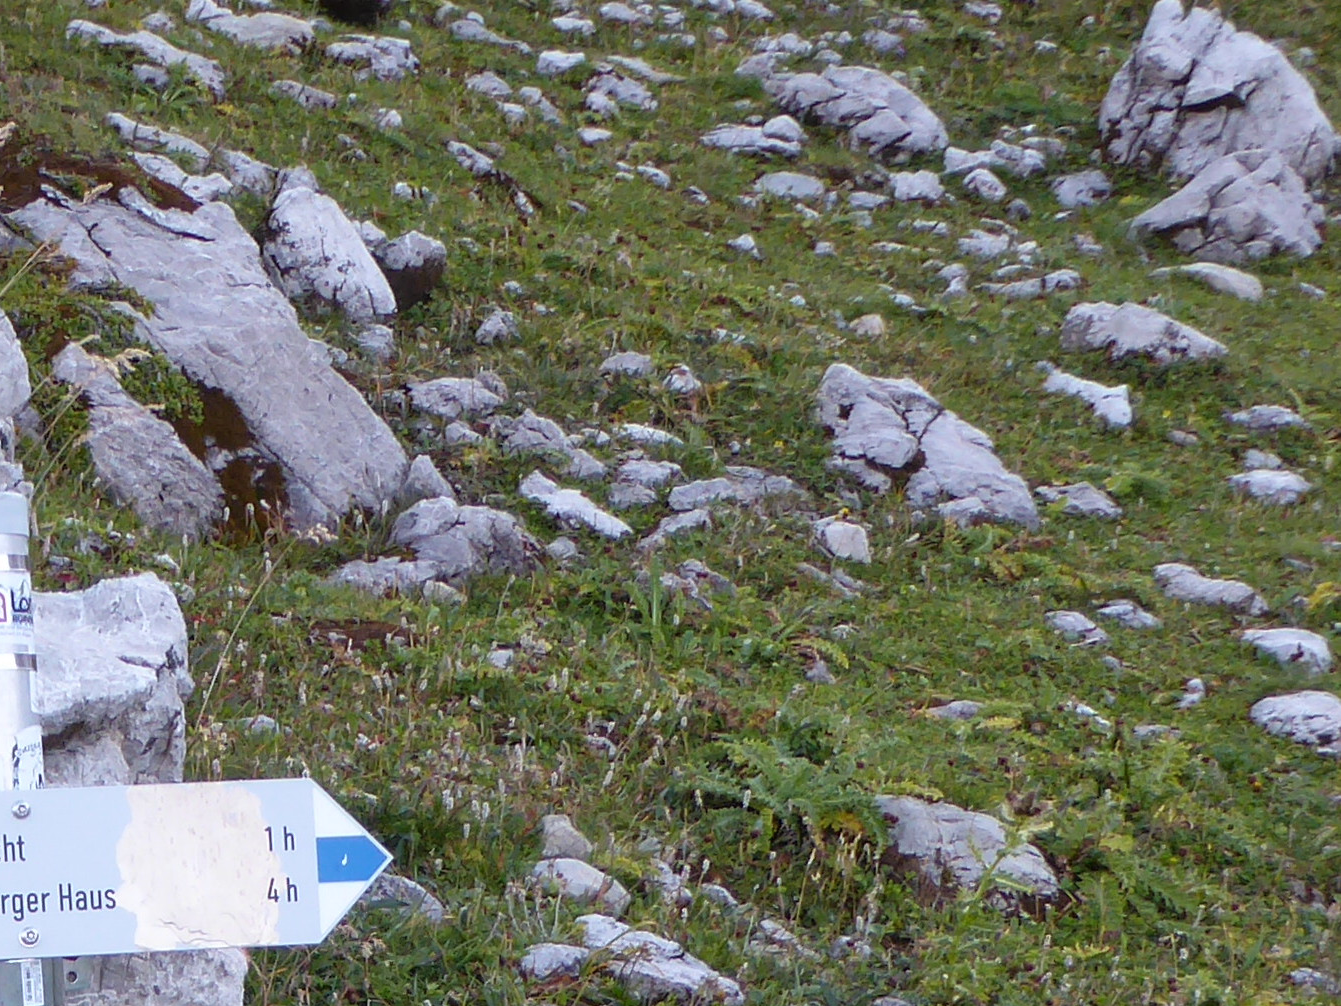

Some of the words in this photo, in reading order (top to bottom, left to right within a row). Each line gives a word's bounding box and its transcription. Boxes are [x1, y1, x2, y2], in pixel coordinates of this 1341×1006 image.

[264, 826, 273, 852] 1
[283, 826, 295, 851] h
[59, 883, 117, 912] Haus
[267, 877, 279, 903] 4
[286, 877, 298, 902] h
